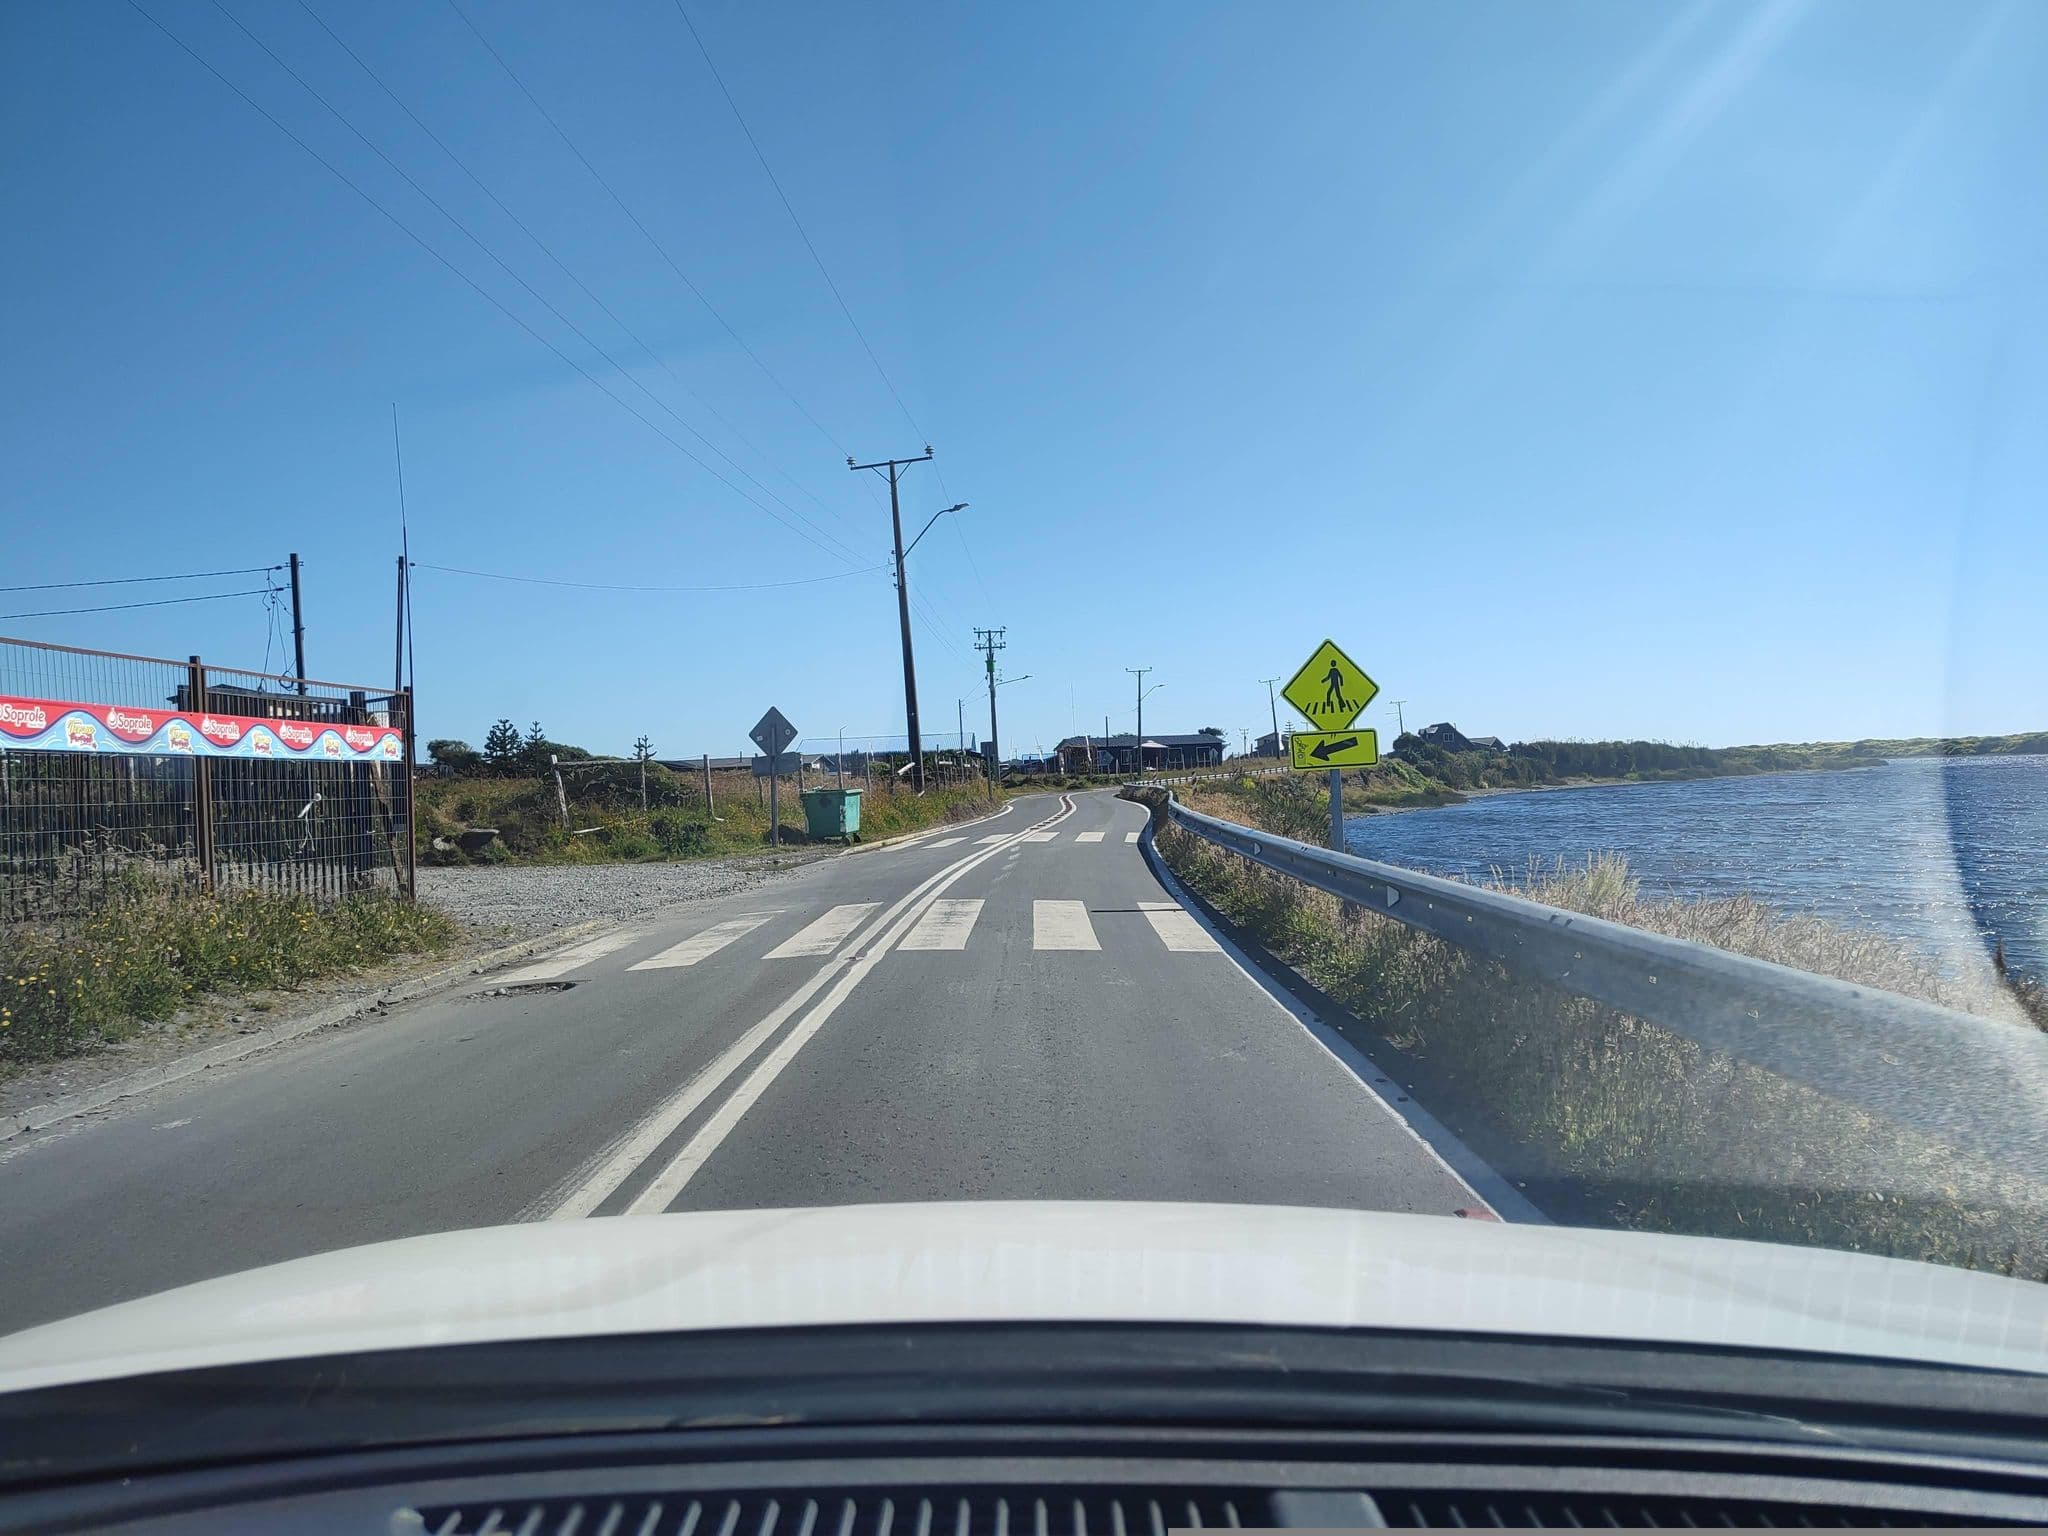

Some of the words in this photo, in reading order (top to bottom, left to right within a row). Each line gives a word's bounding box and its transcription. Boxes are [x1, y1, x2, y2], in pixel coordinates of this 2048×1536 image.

[3, 704, 46, 727] Soprole
[117, 713, 152, 733] Soprole
[210, 720, 239, 738] Soprole
